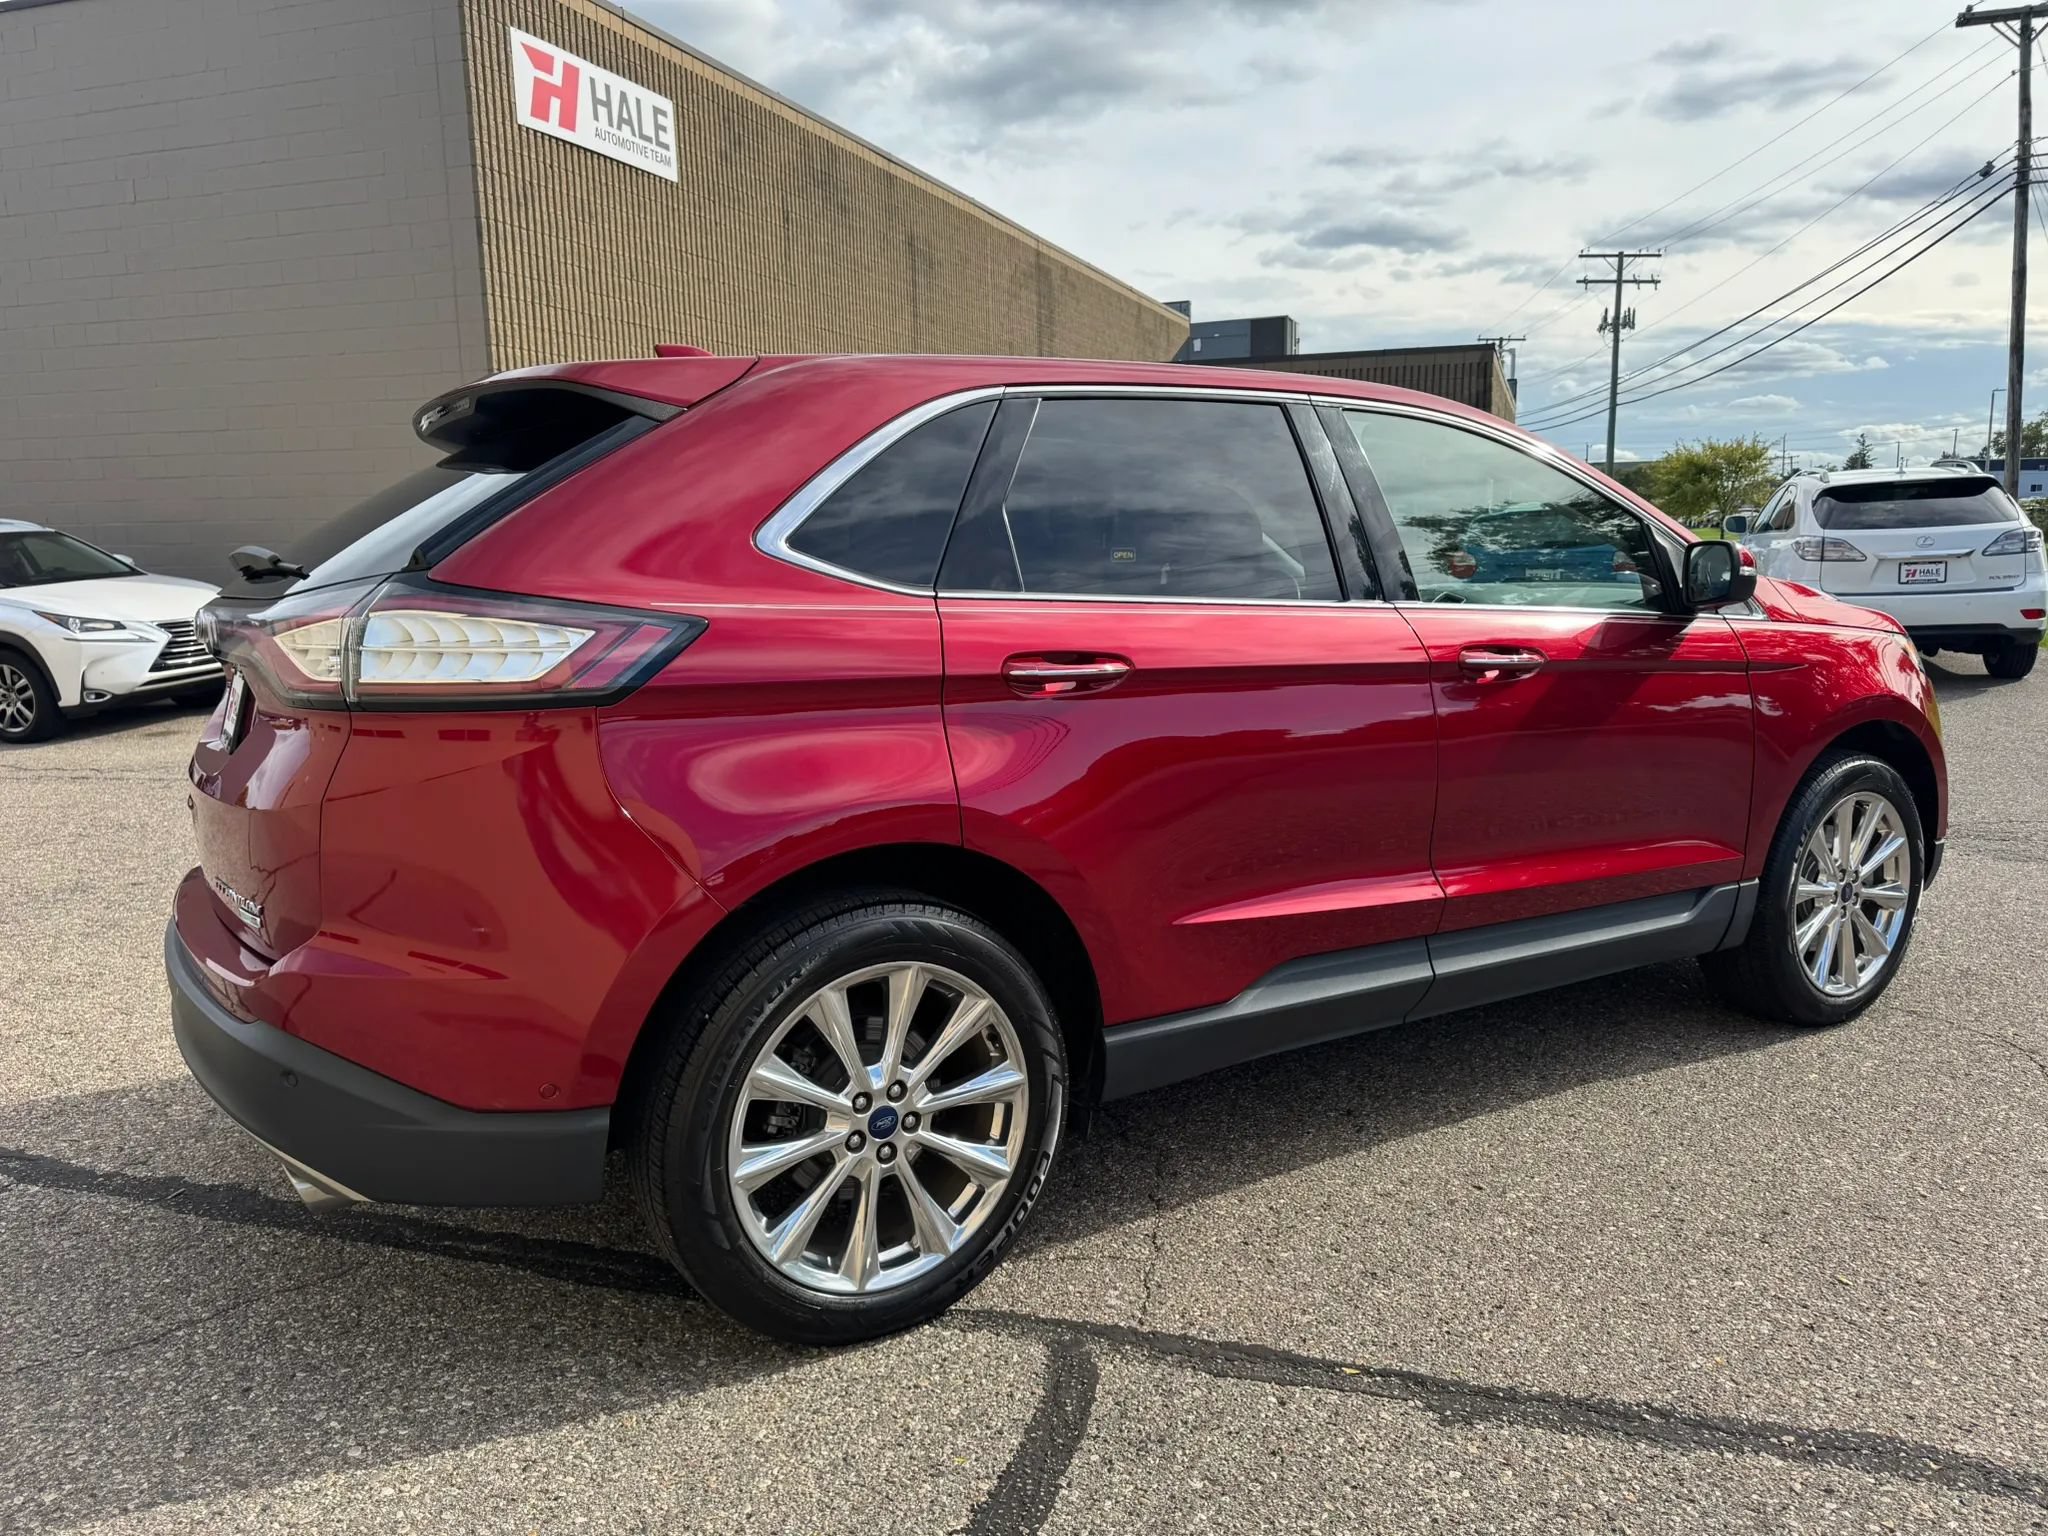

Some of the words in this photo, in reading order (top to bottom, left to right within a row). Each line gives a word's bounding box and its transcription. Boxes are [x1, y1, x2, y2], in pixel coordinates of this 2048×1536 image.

[590, 76, 670, 150] HALE
[594, 127, 649, 159] AUTOMOTIVE
[650, 149, 672, 168] TEAM
[1113, 551, 1133, 559] OPEN
[1919, 567, 1941, 575] HALE
[954, 1150, 1051, 1292] COOPER
